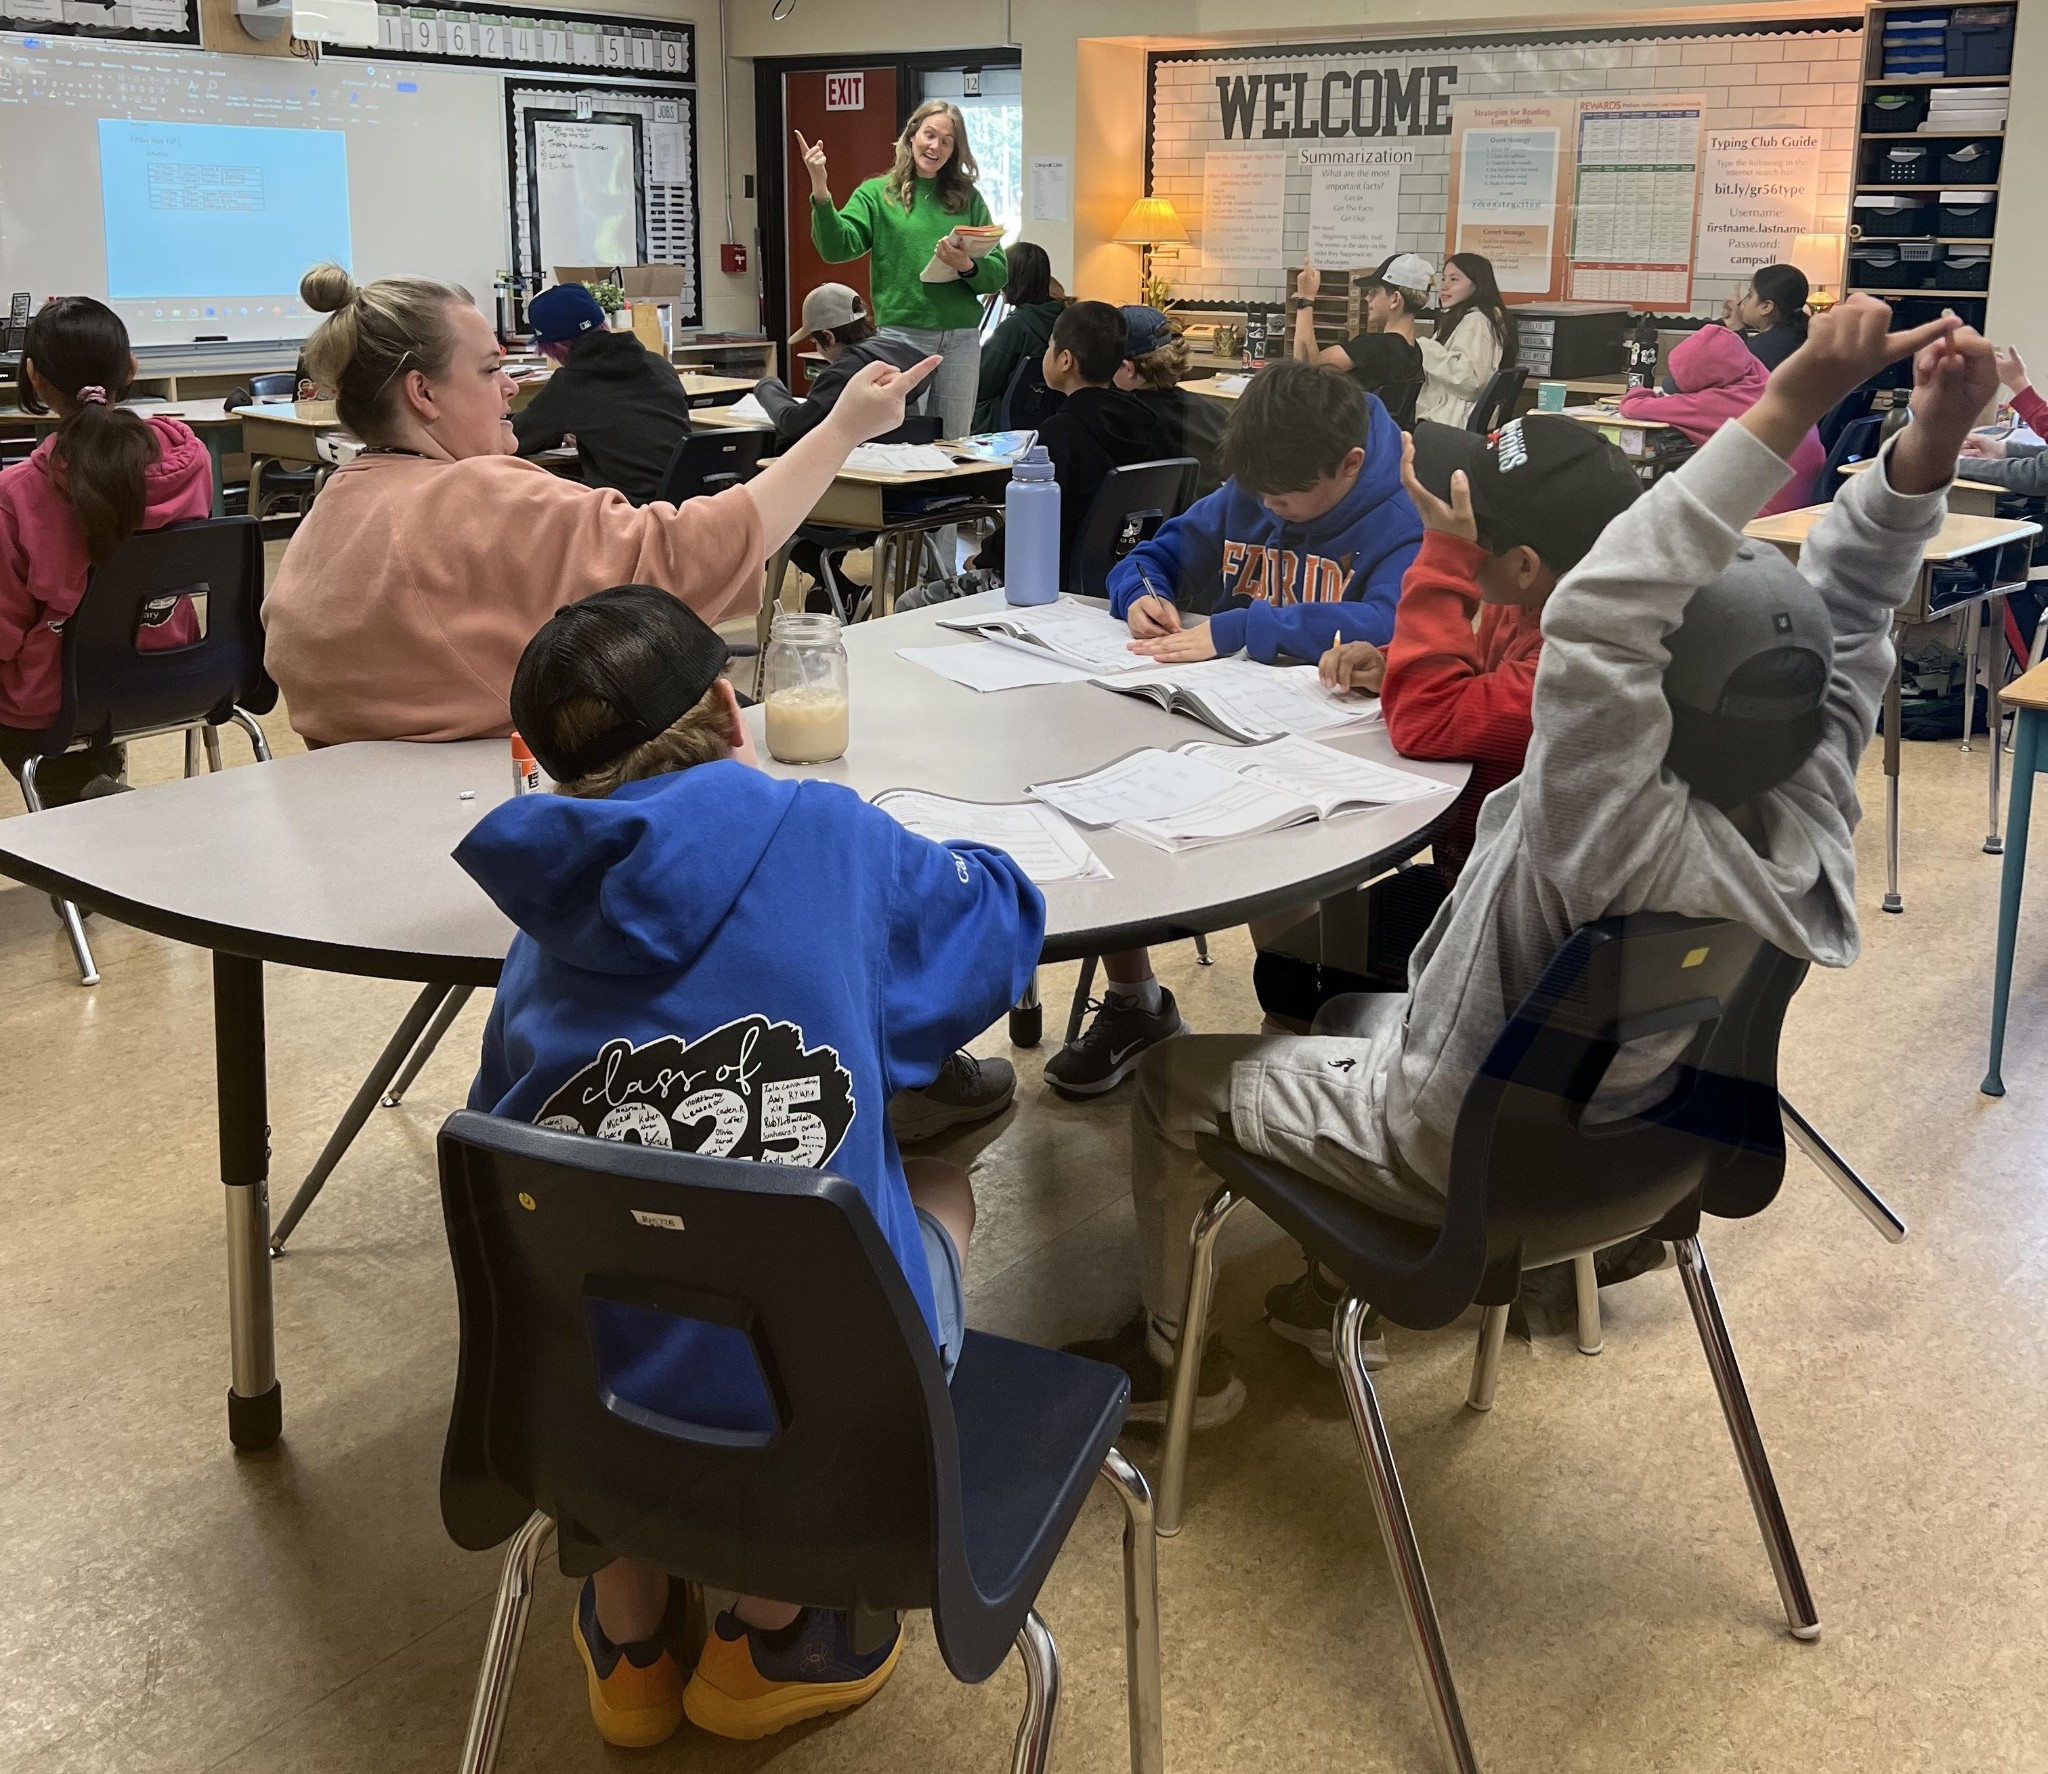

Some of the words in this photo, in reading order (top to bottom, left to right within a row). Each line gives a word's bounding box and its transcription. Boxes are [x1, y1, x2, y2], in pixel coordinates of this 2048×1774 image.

[386, 19, 392, 45] 1
[420, 22, 430, 48] 9
[486, 27, 496, 53] 2
[520, 30, 528, 56] 4
[550, 32, 558, 58] 7
[609, 38, 618, 62] 5
[667, 44, 676, 68] 9
[966, 78, 978, 90] 12
[828, 78, 862, 106] EXIT
[580, 101, 590, 113] 11
[1216, 66, 1458, 140] WELCOME
[1580, 101, 1622, 110] REWARDS
[657, 106, 675, 119] JOBS
[1474, 109, 1508, 118] Strategies
[1510, 108, 1521, 116] for
[1522, 108, 1551, 117] Reading
[1491, 118, 1508, 126] Long
[1510, 117, 1532, 125] Words
[1711, 138, 1748, 150] Typing
[1751, 137, 1778, 147] Club
[1782, 136, 1818, 147] Guide
[1300, 148, 1412, 164] Summarization
[1717, 160, 1734, 168] Type
[1749, 159, 1783, 168] following
[1326, 182, 1360, 192] important
[1363, 182, 1384, 190] facts?
[1715, 183, 1805, 198] bit.ly/gr56type
[1472, 200, 1540, 208] reconstruction
[1729, 208, 1785, 217] Username:
[1707, 222, 1807, 234] firstname.lastname
[1728, 239, 1780, 249] Password:
[1730, 254, 1776, 266] campsall
[582, 1049, 706, 1106] class
[716, 1025, 762, 1096] of
